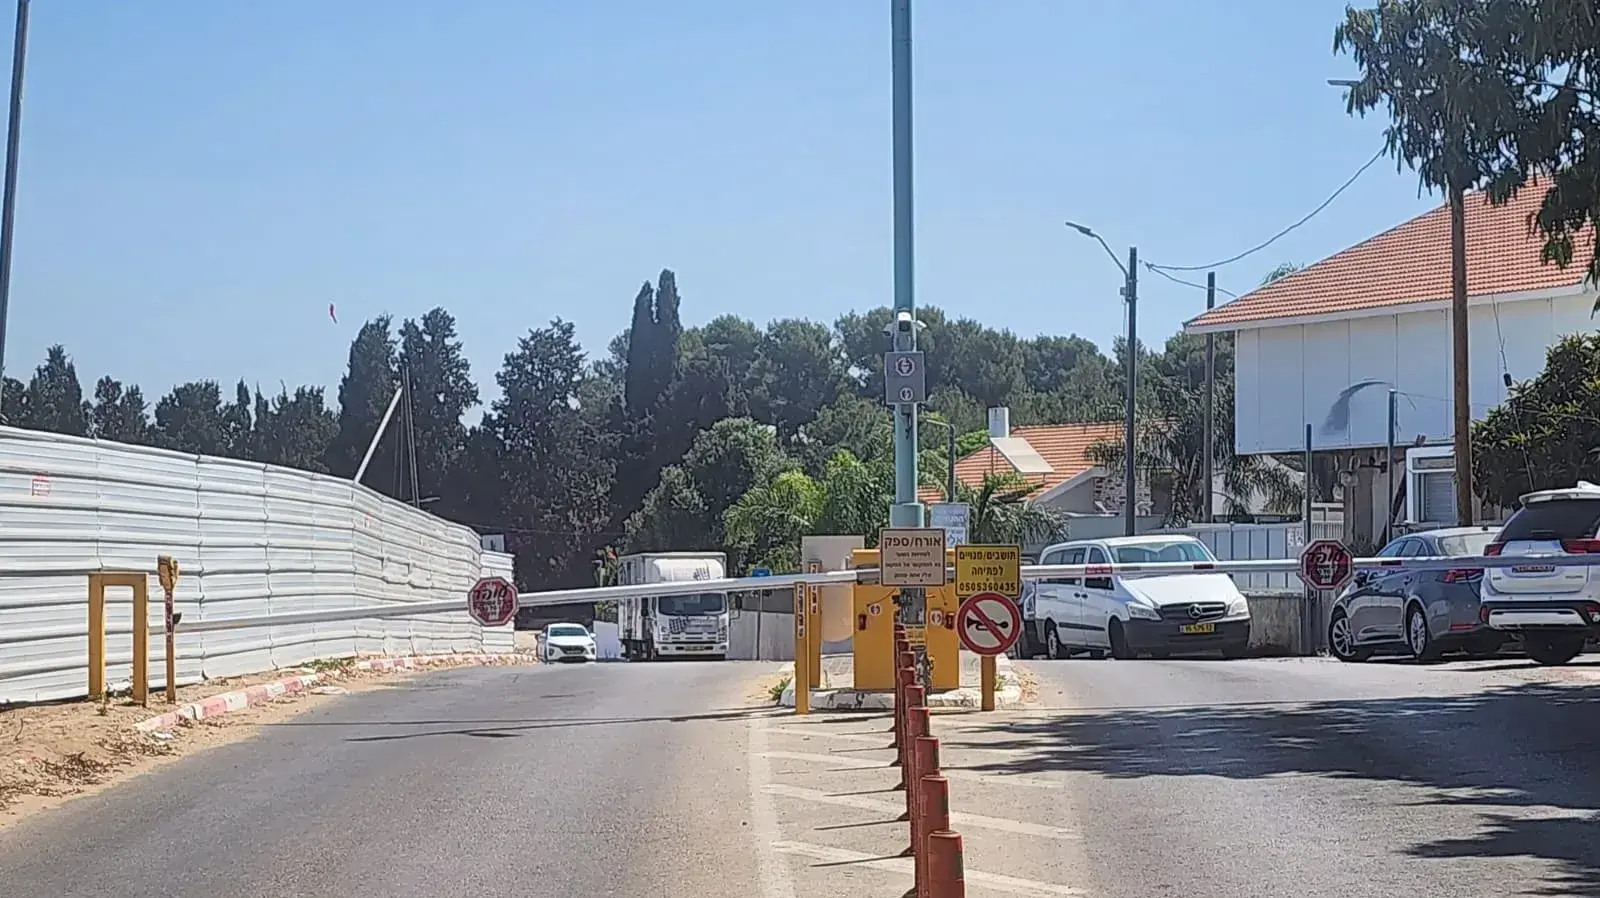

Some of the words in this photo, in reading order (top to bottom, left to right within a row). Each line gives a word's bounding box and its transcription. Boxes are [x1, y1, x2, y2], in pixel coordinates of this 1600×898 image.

[884, 536, 941, 549] אורח/ספק
[959, 551, 1016, 560] תושבים/מנויים
[971, 565, 1004, 576] לפתיחה
